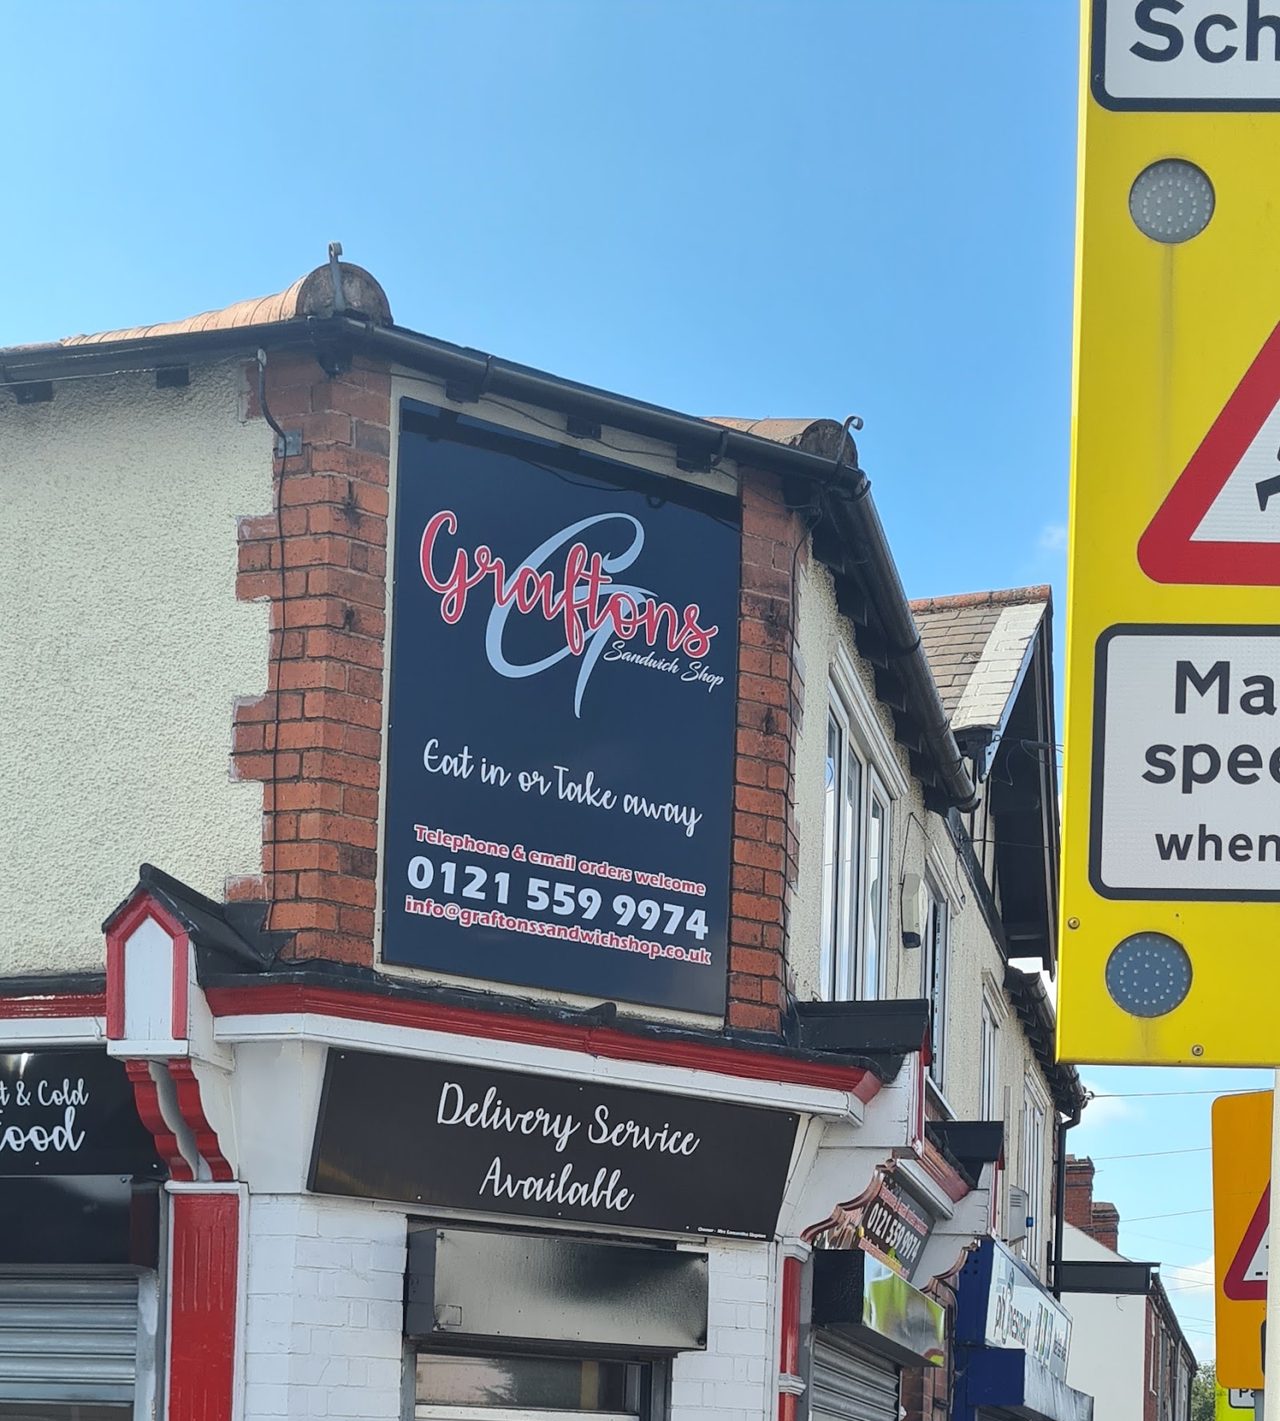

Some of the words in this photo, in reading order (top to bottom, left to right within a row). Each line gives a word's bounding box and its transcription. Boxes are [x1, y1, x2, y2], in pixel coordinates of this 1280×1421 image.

[420, 510, 719, 658] Graftons
[603, 640, 680, 674] Sandwich
[681, 661, 724, 693] Shop
[1174, 660, 1278, 715] Ma
[423, 739, 474, 779] Eat
[481, 758, 511, 786] in
[518, 770, 551, 795] or
[553, 765, 617, 810] Take
[623, 794, 702, 837] away
[414, 824, 509, 858] Telephone
[512, 845, 526, 862] &
[528, 850, 575, 872] email
[579, 859, 631, 882] orders
[634, 868, 707, 896] welcome
[1155, 824, 1280, 861] when
[405, 895, 712, 965] info@graftonssandwichshop.co.uk
[407, 855, 511, 904] 0121
[527, 878, 601, 920] 559
[612, 894, 709, 940] 9974
[16, 1080, 31, 1106] &
[38, 1078, 89, 1106] Cold
[437, 1082, 581, 1152] Delivery
[588, 1105, 700, 1156] Service
[478, 1156, 635, 1211] Available
[867, 1203, 892, 1239] 0121
[885, 1219, 904, 1249] 559
[899, 1229, 921, 1263] 9974
